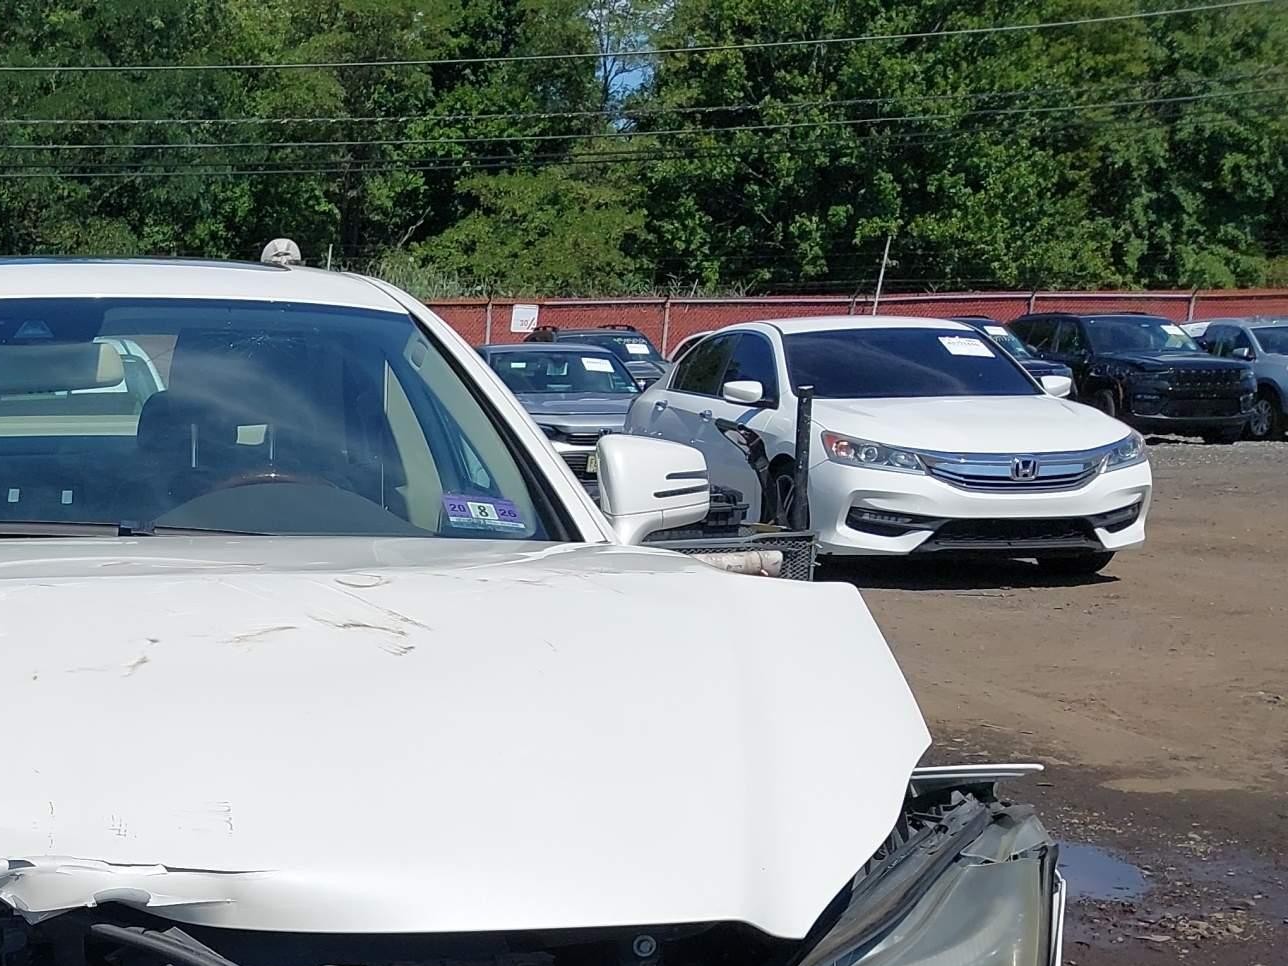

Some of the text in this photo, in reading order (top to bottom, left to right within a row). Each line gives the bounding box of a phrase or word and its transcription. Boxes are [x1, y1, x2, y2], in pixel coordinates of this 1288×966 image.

[449, 503, 517, 518] 20 8 26
